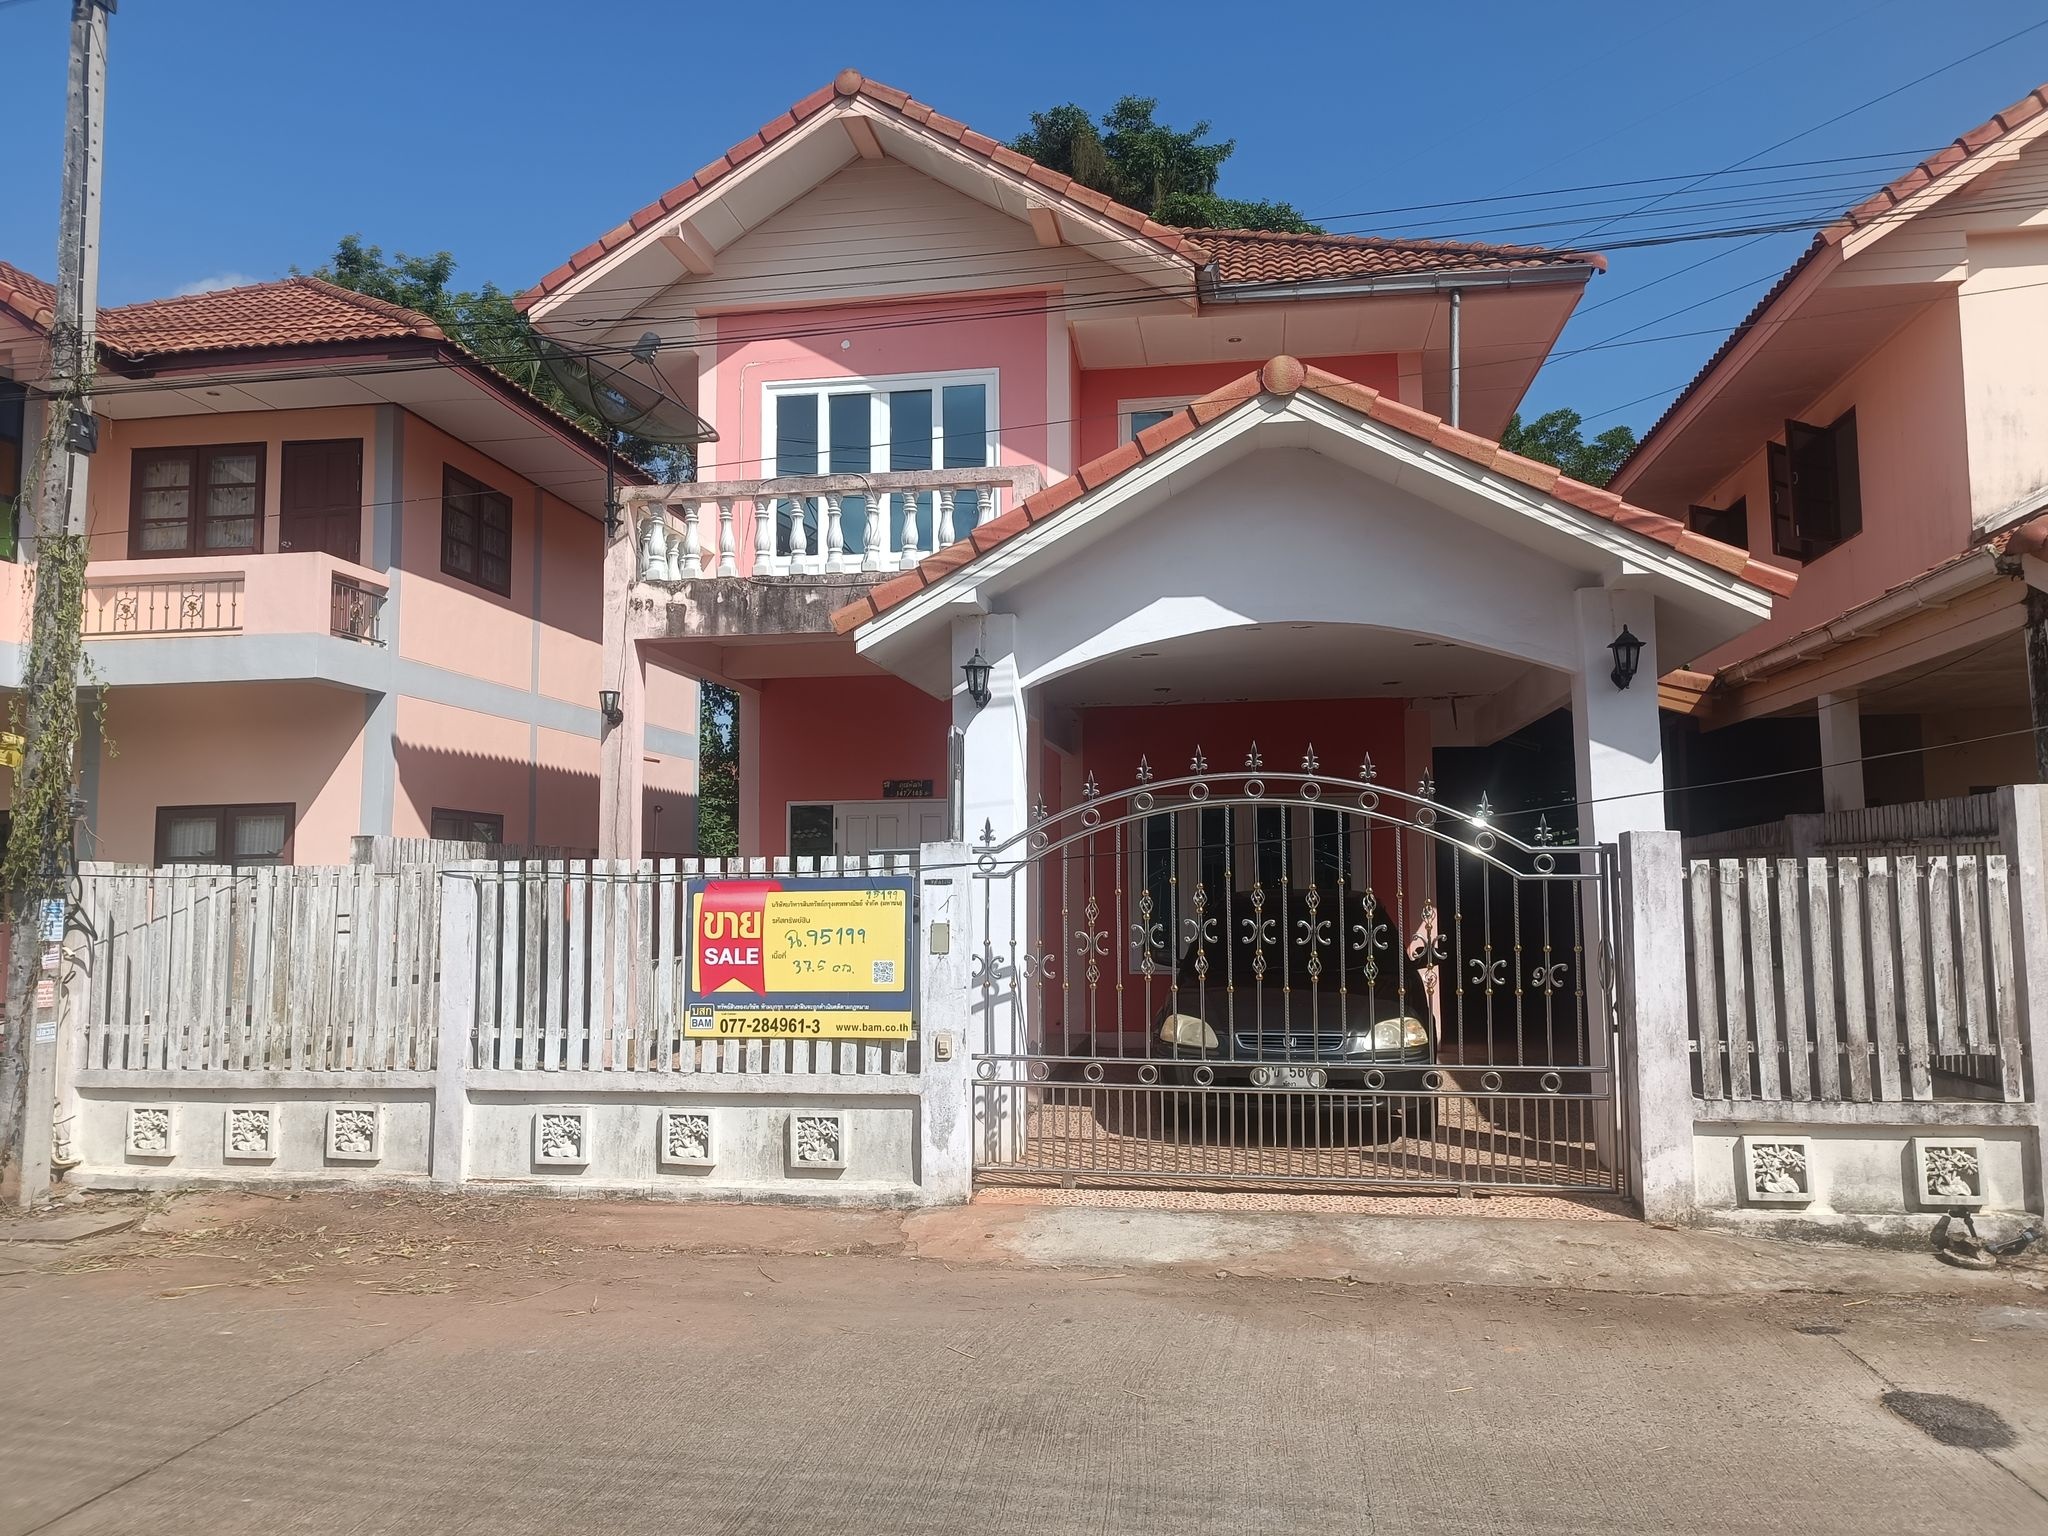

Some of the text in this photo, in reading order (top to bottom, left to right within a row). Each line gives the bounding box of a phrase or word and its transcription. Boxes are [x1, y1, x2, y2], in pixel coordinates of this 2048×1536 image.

[703, 911, 761, 939] ขาย
[704, 947, 760, 966] SALE
[691, 1006, 712, 1016] บสก
[691, 1018, 712, 1028] BAM
[720, 1017, 909, 1034] 077-284961-3 www.bam.co.th
